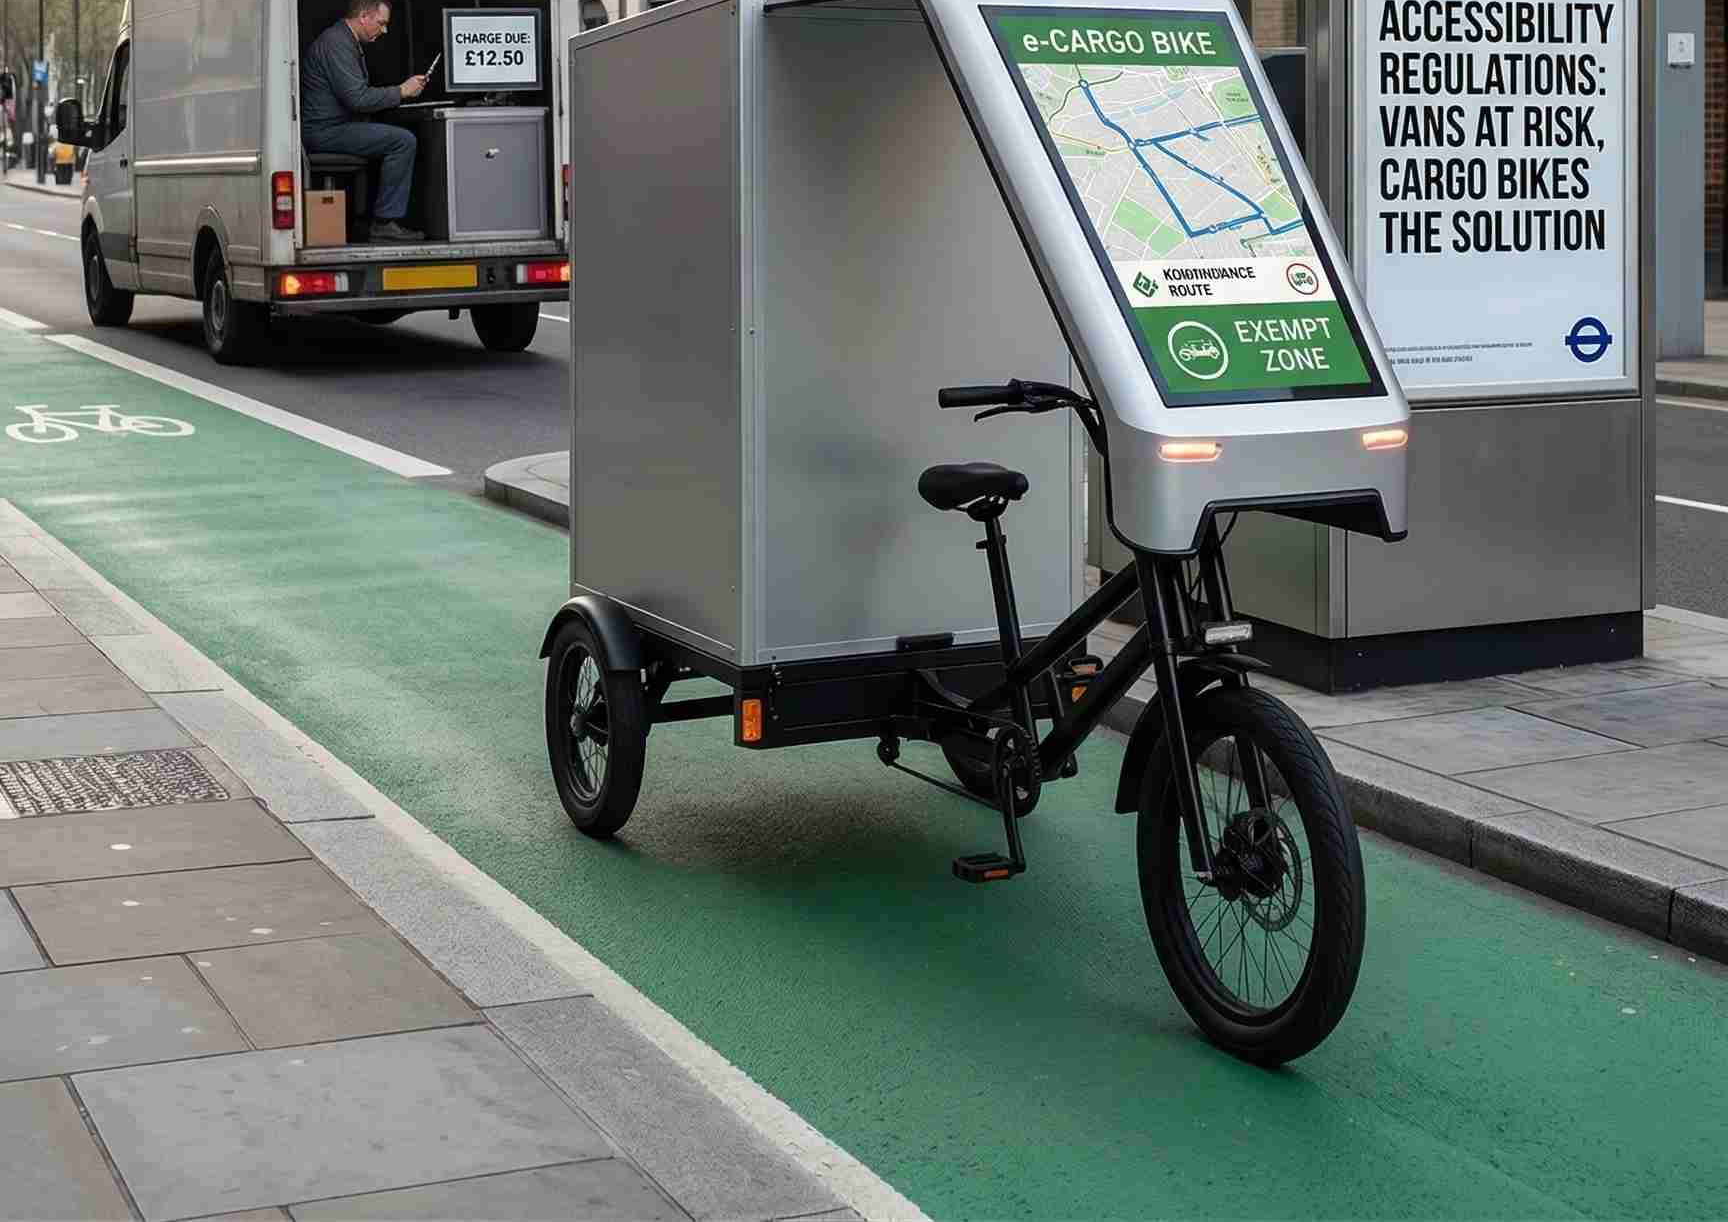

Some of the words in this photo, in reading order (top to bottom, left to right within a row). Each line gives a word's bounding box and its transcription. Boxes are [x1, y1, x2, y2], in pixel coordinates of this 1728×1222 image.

[1379, 0, 1615, 44] ACCESSIBILITY
[455, 32, 503, 44] CHARGE
[504, 32, 531, 44] DUE:
[1023, 28, 1145, 55] e-CARGO
[1151, 30, 1217, 55] BIKE
[465, 50, 524, 66] £12.50
[1379, 52, 1607, 96] REGULATIONS:
[1379, 105, 1466, 148] VANS
[1475, 105, 1514, 147] AT
[1523, 105, 1605, 153] RISK,
[1379, 158, 1487, 201] CARGO
[1498, 157, 1590, 200] BIKES
[1379, 211, 1442, 254] THE
[1452, 209, 1606, 253] SOLUTION
[1169, 283, 1213, 297] ROUTE
[1234, 317, 1331, 344] EXEMPT
[1261, 347, 1331, 373] ZONE
